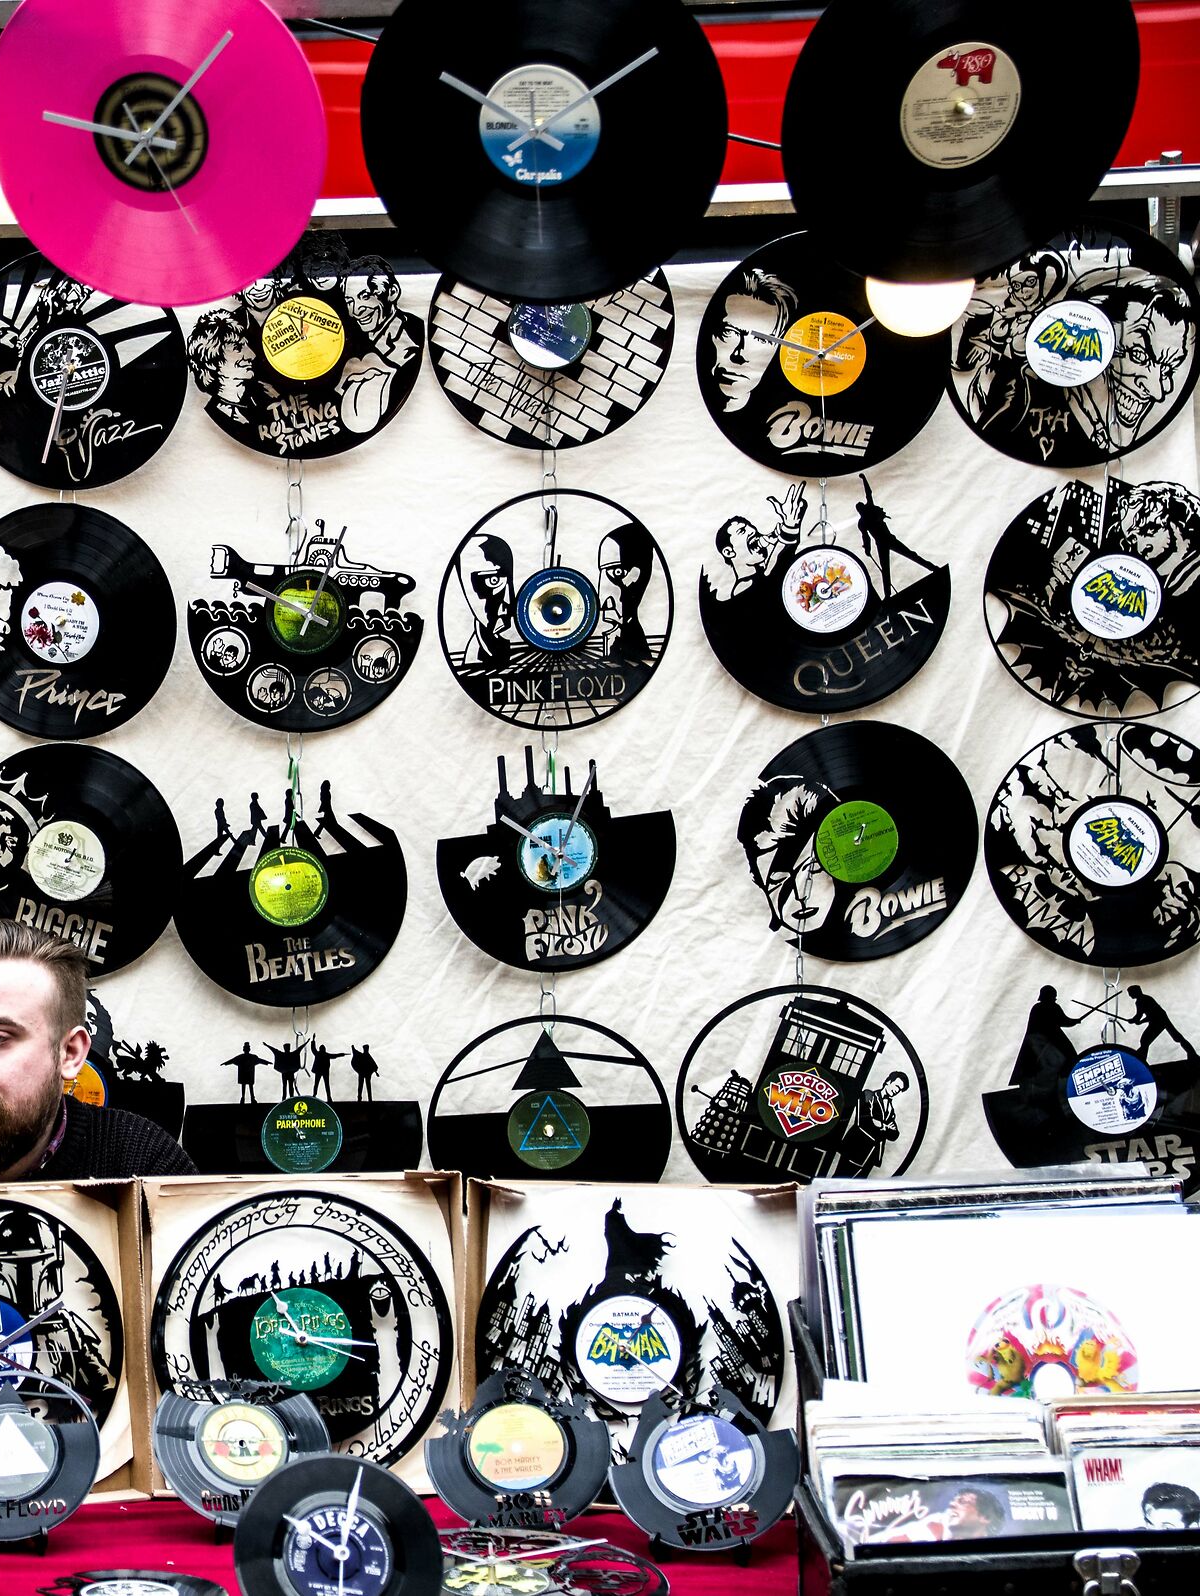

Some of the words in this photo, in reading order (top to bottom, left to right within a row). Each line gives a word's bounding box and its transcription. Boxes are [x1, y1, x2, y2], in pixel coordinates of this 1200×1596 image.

[962, 53, 992, 73] RSO
[265, 323, 295, 345] Rolling
[266, 318, 283, 333] The
[308, 310, 341, 331] Fingers
[270, 333, 300, 353] Stones
[1038, 321, 1101, 359] BATMAN
[39, 374, 69, 390] Jaz
[71, 366, 106, 382] Attic
[258, 402, 339, 441] ROLLING
[267, 394, 308, 421] THE
[275, 420, 340, 455] STONES
[1085, 572, 1146, 617] BATMAN
[793, 598, 934, 696] QUEEN
[14, 668, 127, 726] Prince
[488, 677, 544, 704] PINK
[550, 674, 626, 700] FLOYD
[1088, 817, 1144, 871] BATMAN
[522, 879, 604, 935] PINK
[1008, 864, 1095, 950] BATMAN
[283, 937, 312, 953] THE
[245, 942, 356, 984] BEATLES
[782, 1073, 835, 1099] DOCTOR
[1074, 1058, 1121, 1086] EMPIRE
[768, 1083, 835, 1124] WHO
[276, 1118, 326, 1130] PARLOPHONE
[1083, 1133, 1194, 1165] STAR
[318, 1396, 374, 1416] RINGS
[1083, 1458, 1124, 1483] WHAM!
[6, 1498, 67, 1518] FLOYD
[487, 1508, 569, 1528] MARLEY
[677, 1503, 759, 1532] STAR
[313, 1511, 371, 1539] DECCA
[678, 1517, 760, 1547] WARS
